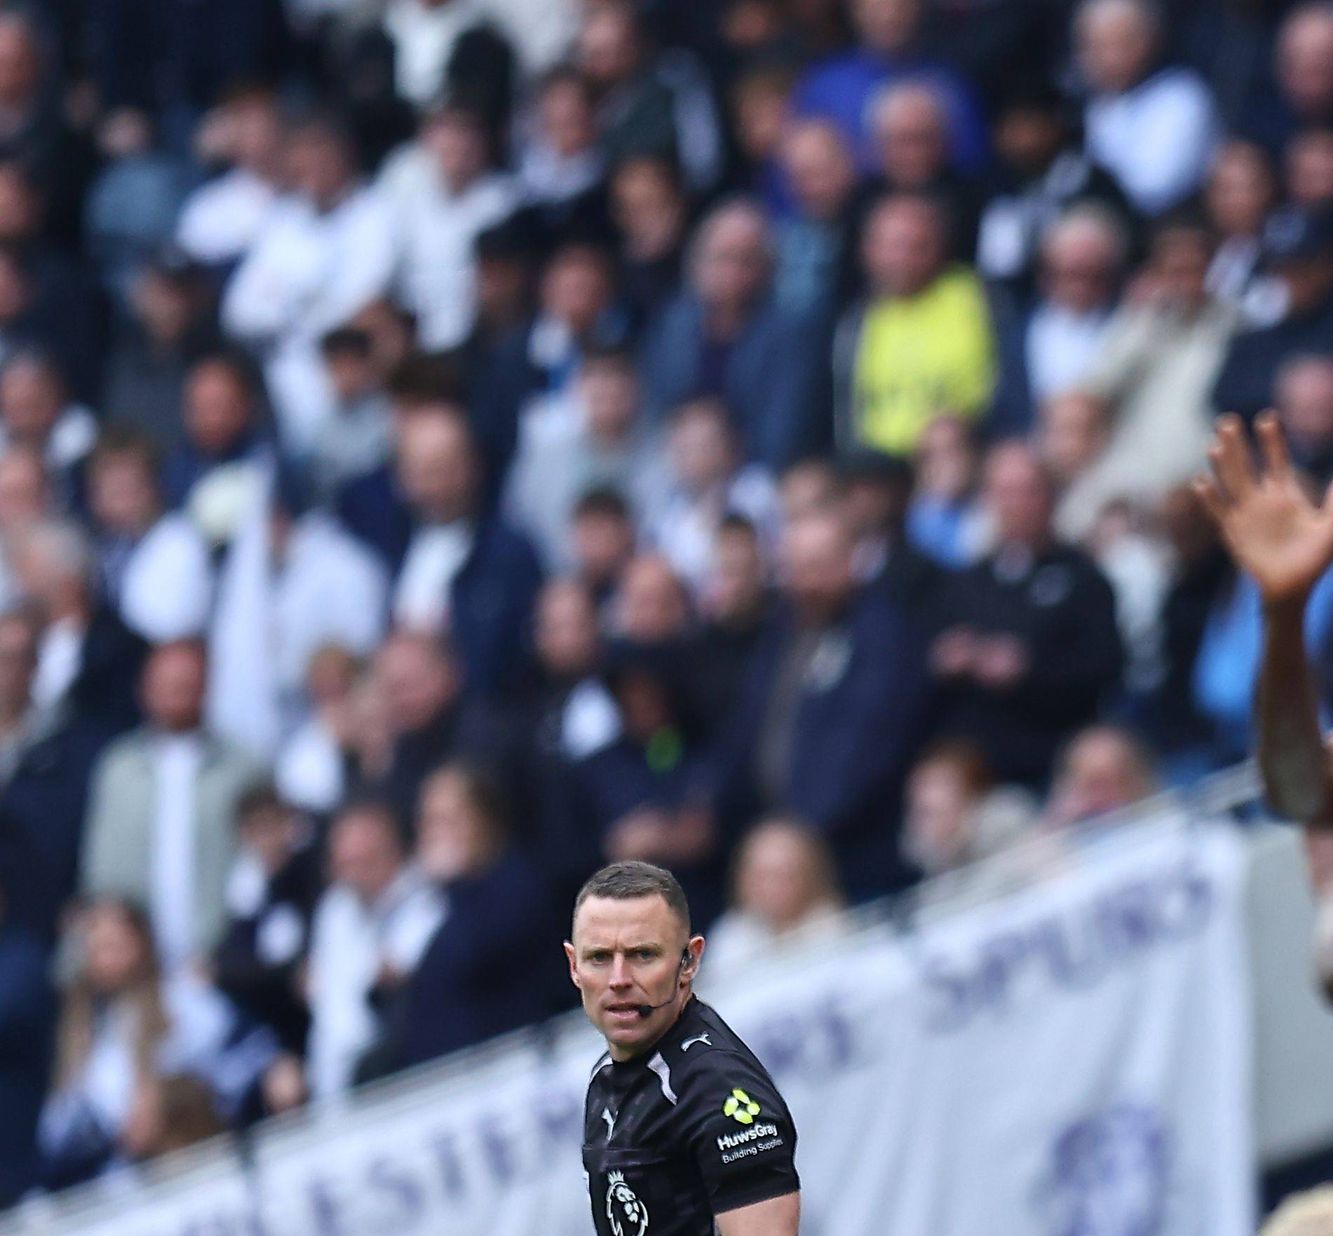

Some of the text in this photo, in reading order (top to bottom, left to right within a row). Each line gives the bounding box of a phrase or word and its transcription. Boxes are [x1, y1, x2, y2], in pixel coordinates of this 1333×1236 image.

[918, 872, 1215, 1032] SPURS
[717, 1123, 778, 1151] HuwsGray
[722, 1147, 758, 1164] Building
